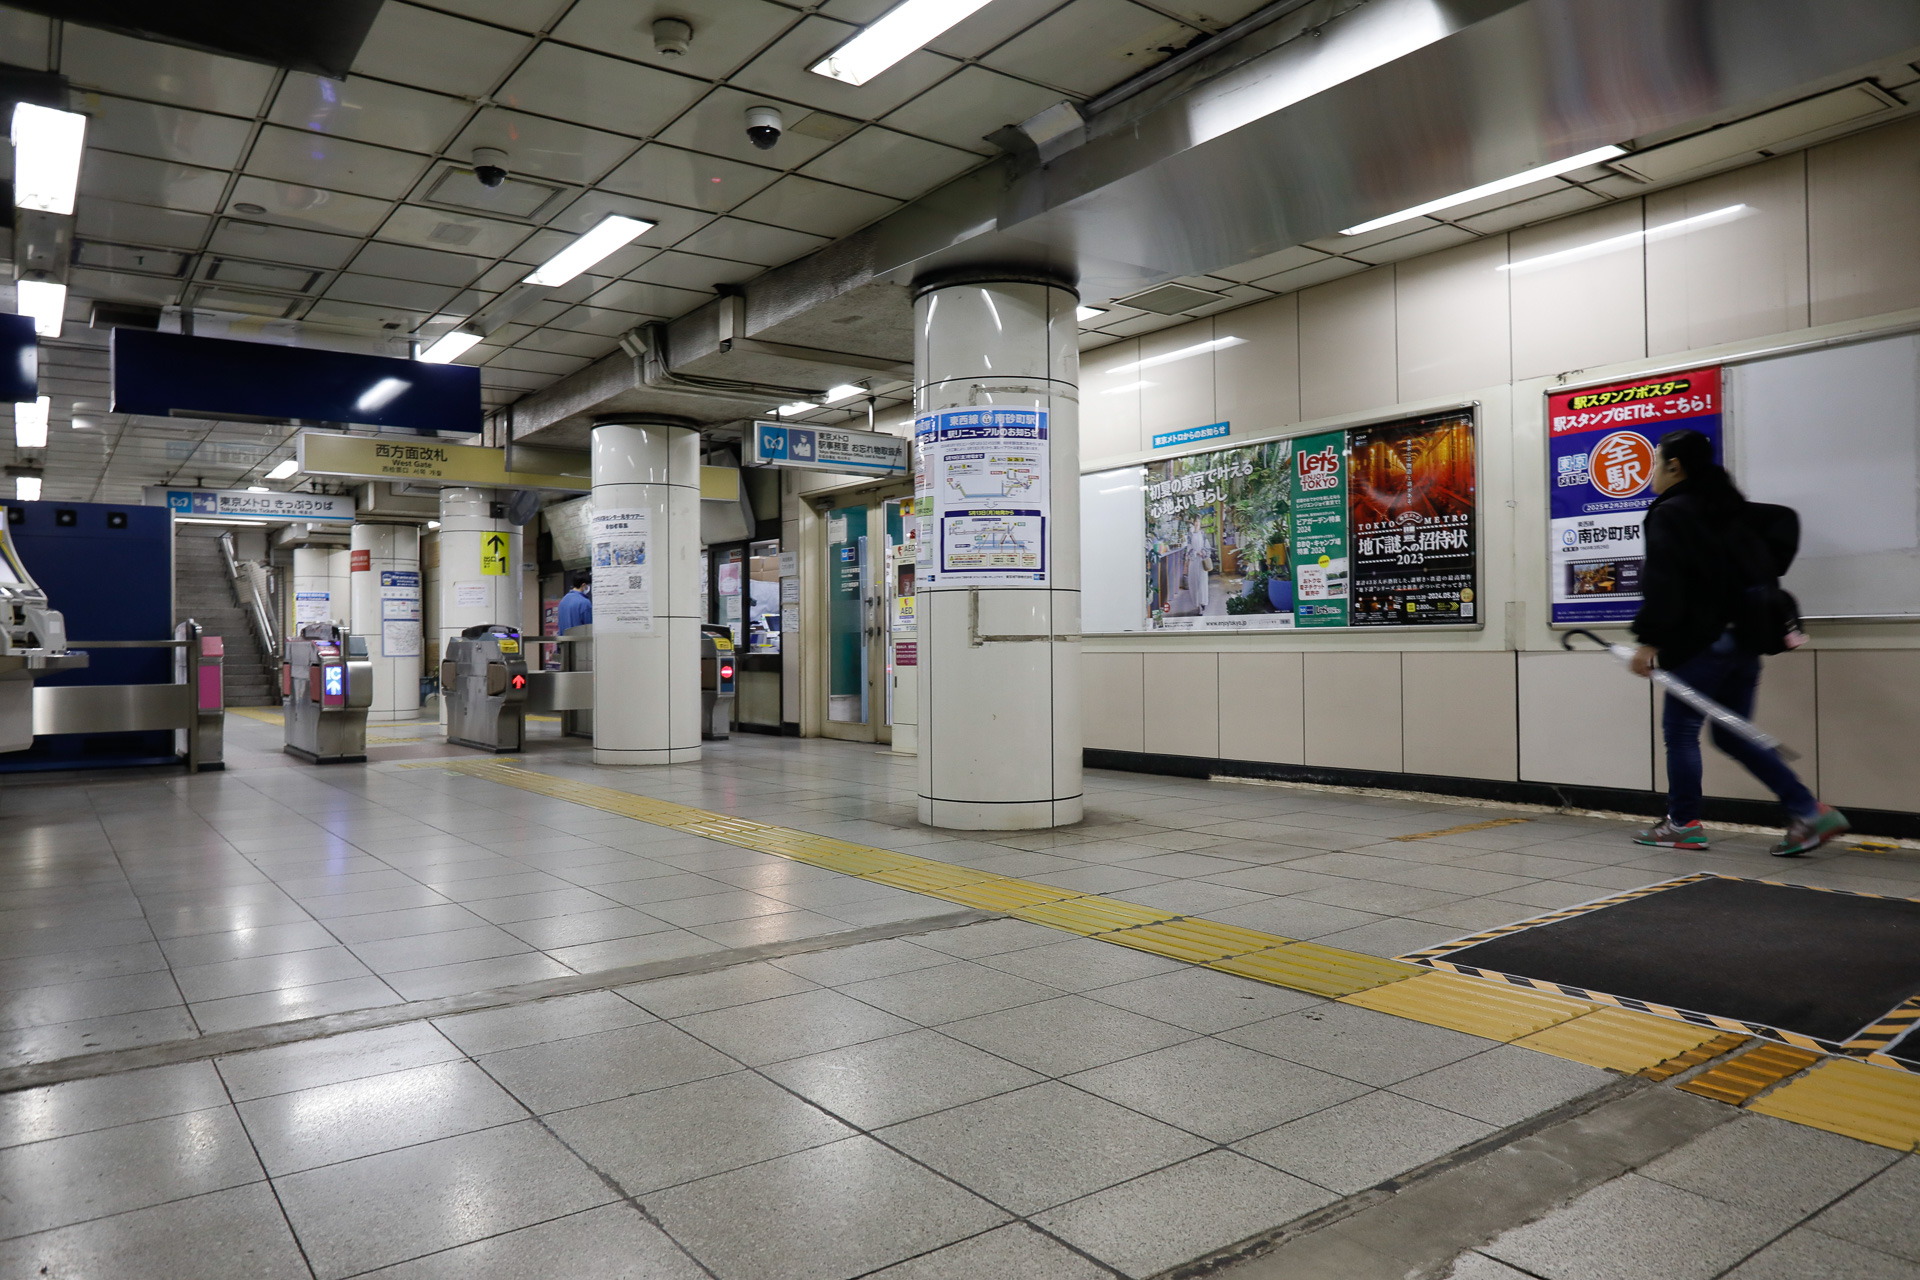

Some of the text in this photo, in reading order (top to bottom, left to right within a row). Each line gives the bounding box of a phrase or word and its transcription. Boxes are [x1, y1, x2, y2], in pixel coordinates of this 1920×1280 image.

[1573, 381, 1689, 409] 駅スタンプポスター
[818, 432, 849, 442] 東京メトロ
[947, 428, 1039, 438] 駅リニューアルのお知らせ
[1154, 426, 1227, 446] 東京メトロからのお知らせ
[376, 443, 448, 462] 西方面改札
[1299, 446, 1338, 475] Let's
[392, 459, 412, 467] West
[1559, 453, 1588, 472] 東京
[1600, 437, 1646, 491] 全駅
[1149, 459, 1254, 501] 初夏の東京で叶える
[1302, 477, 1337, 490] TOKYO
[220, 497, 334, 511] 東京メトロ きっぷうりば
[1150, 486, 1228, 518] 心地よい暮らし
[1358, 513, 1469, 531] TOKYO METRO
[1358, 529, 1469, 556] 地下謎への招待状
[1578, 525, 1641, 544] 南砂町駅
[499, 556, 506, 573] 1
[1396, 553, 1424, 565] 2023
[900, 606, 914, 614] AED
[325, 667, 342, 681] IC
